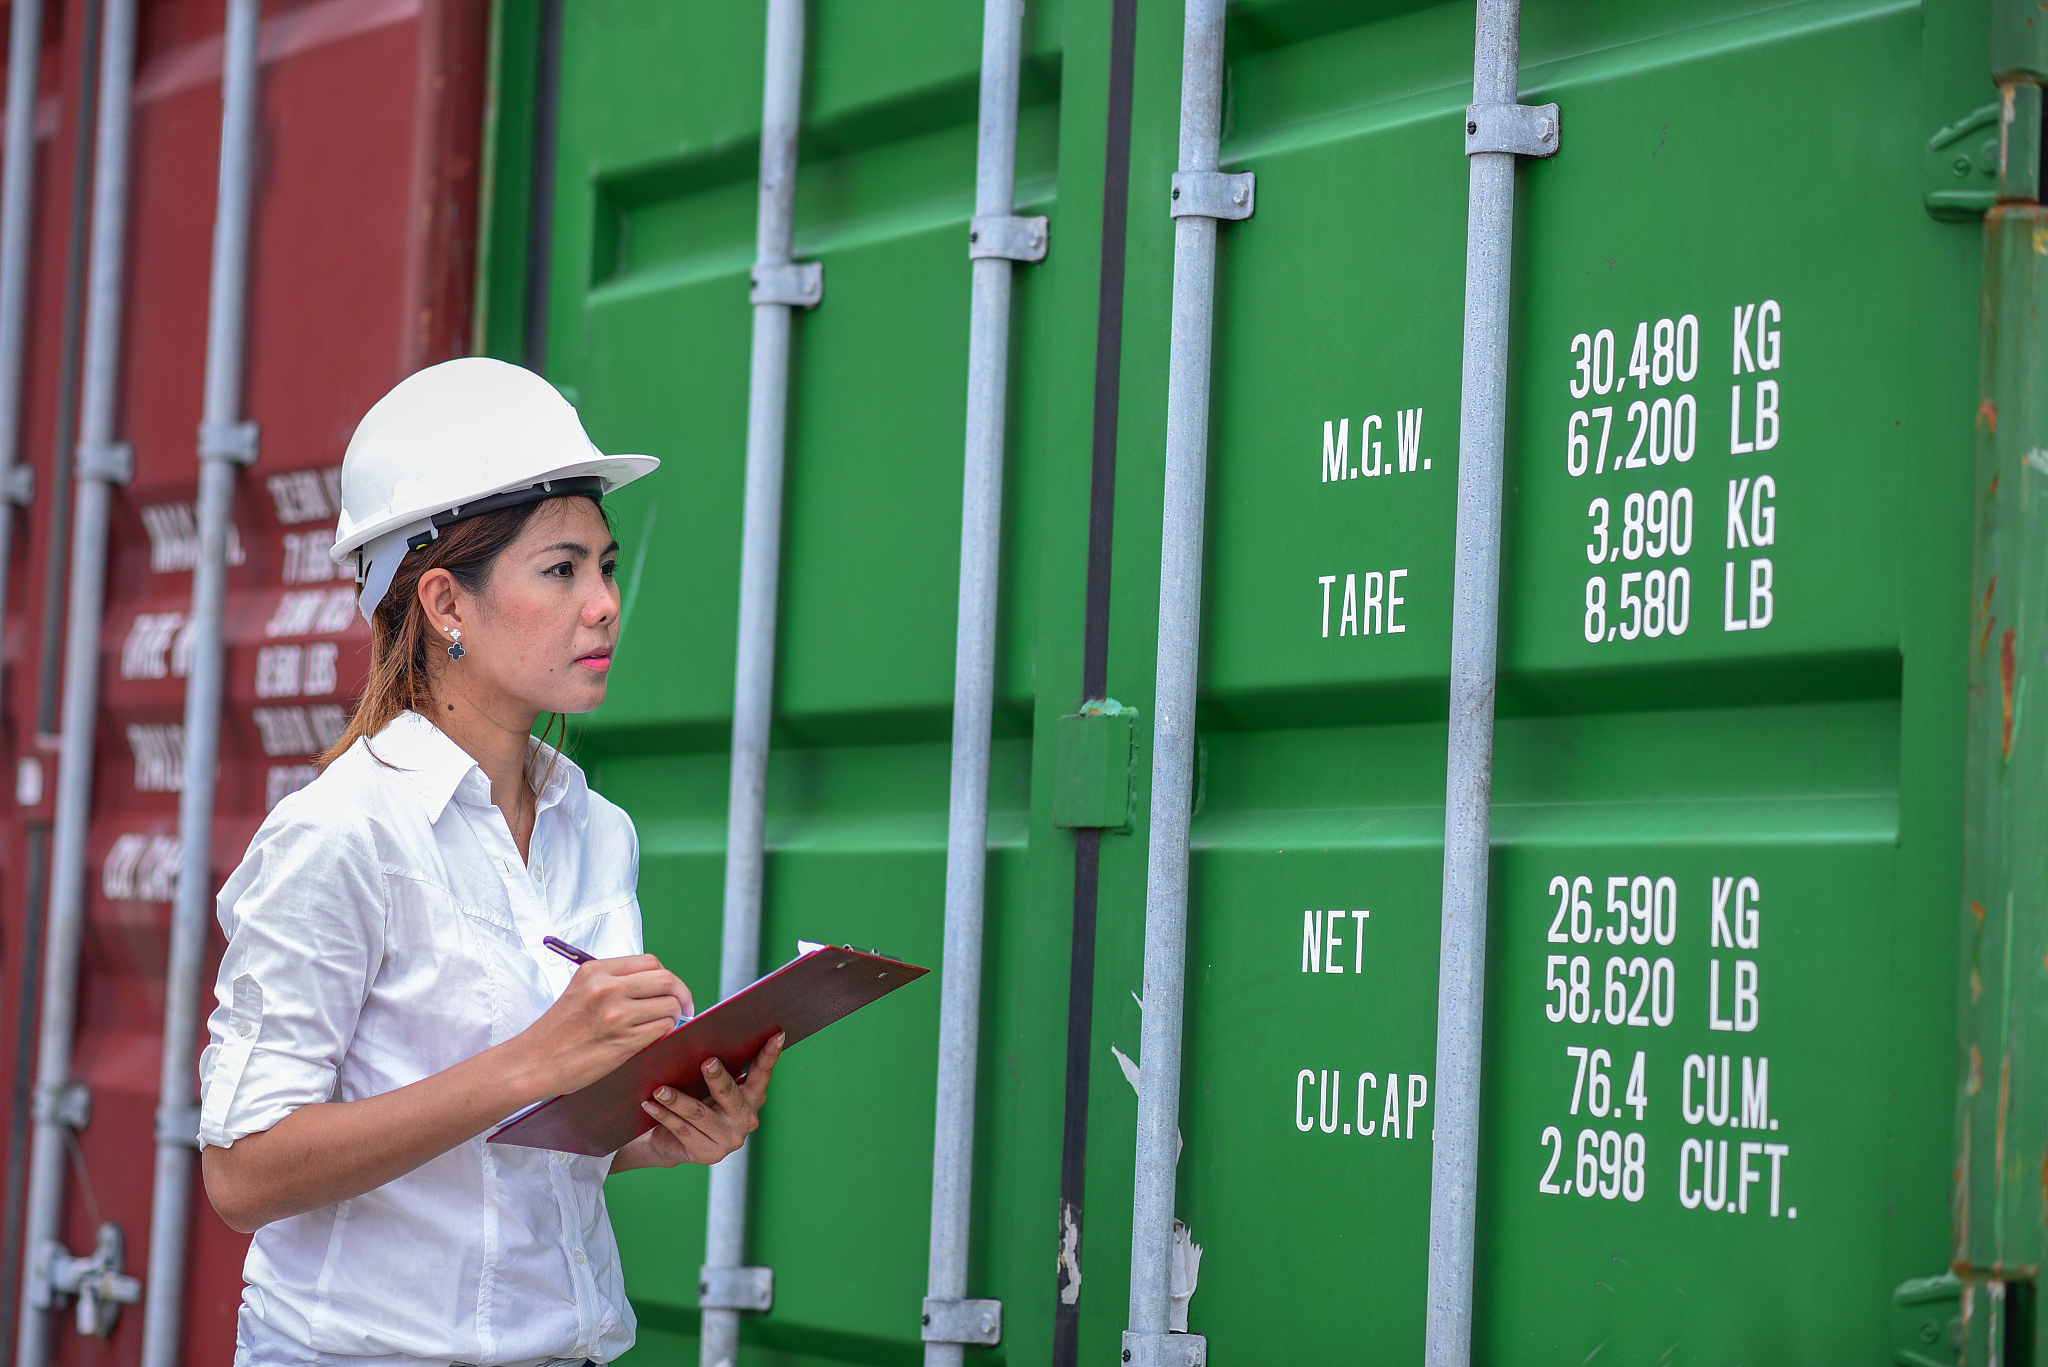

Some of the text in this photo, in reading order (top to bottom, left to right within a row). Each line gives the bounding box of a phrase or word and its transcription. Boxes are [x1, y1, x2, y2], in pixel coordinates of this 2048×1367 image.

[1570, 300, 1781, 398] 30,480 KG
[1322, 408, 1431, 482] M.G.W.
[1568, 380, 1779, 476] 67,200 LB
[1587, 475, 1775, 564] 3,890 KG
[1319, 569, 1407, 638] TARE
[1585, 558, 1773, 643] 8,580 LB
[1302, 911, 1369, 973] NET
[1548, 876, 1759, 949] 26,590 KG
[1546, 955, 1758, 1032] 58,620 LB
[1296, 1069, 1434, 1140] CU.CAP
[1567, 1046, 1778, 1130] 76.4 CU.M.
[1539, 1126, 1796, 1218] 2,698 CU.FT.
